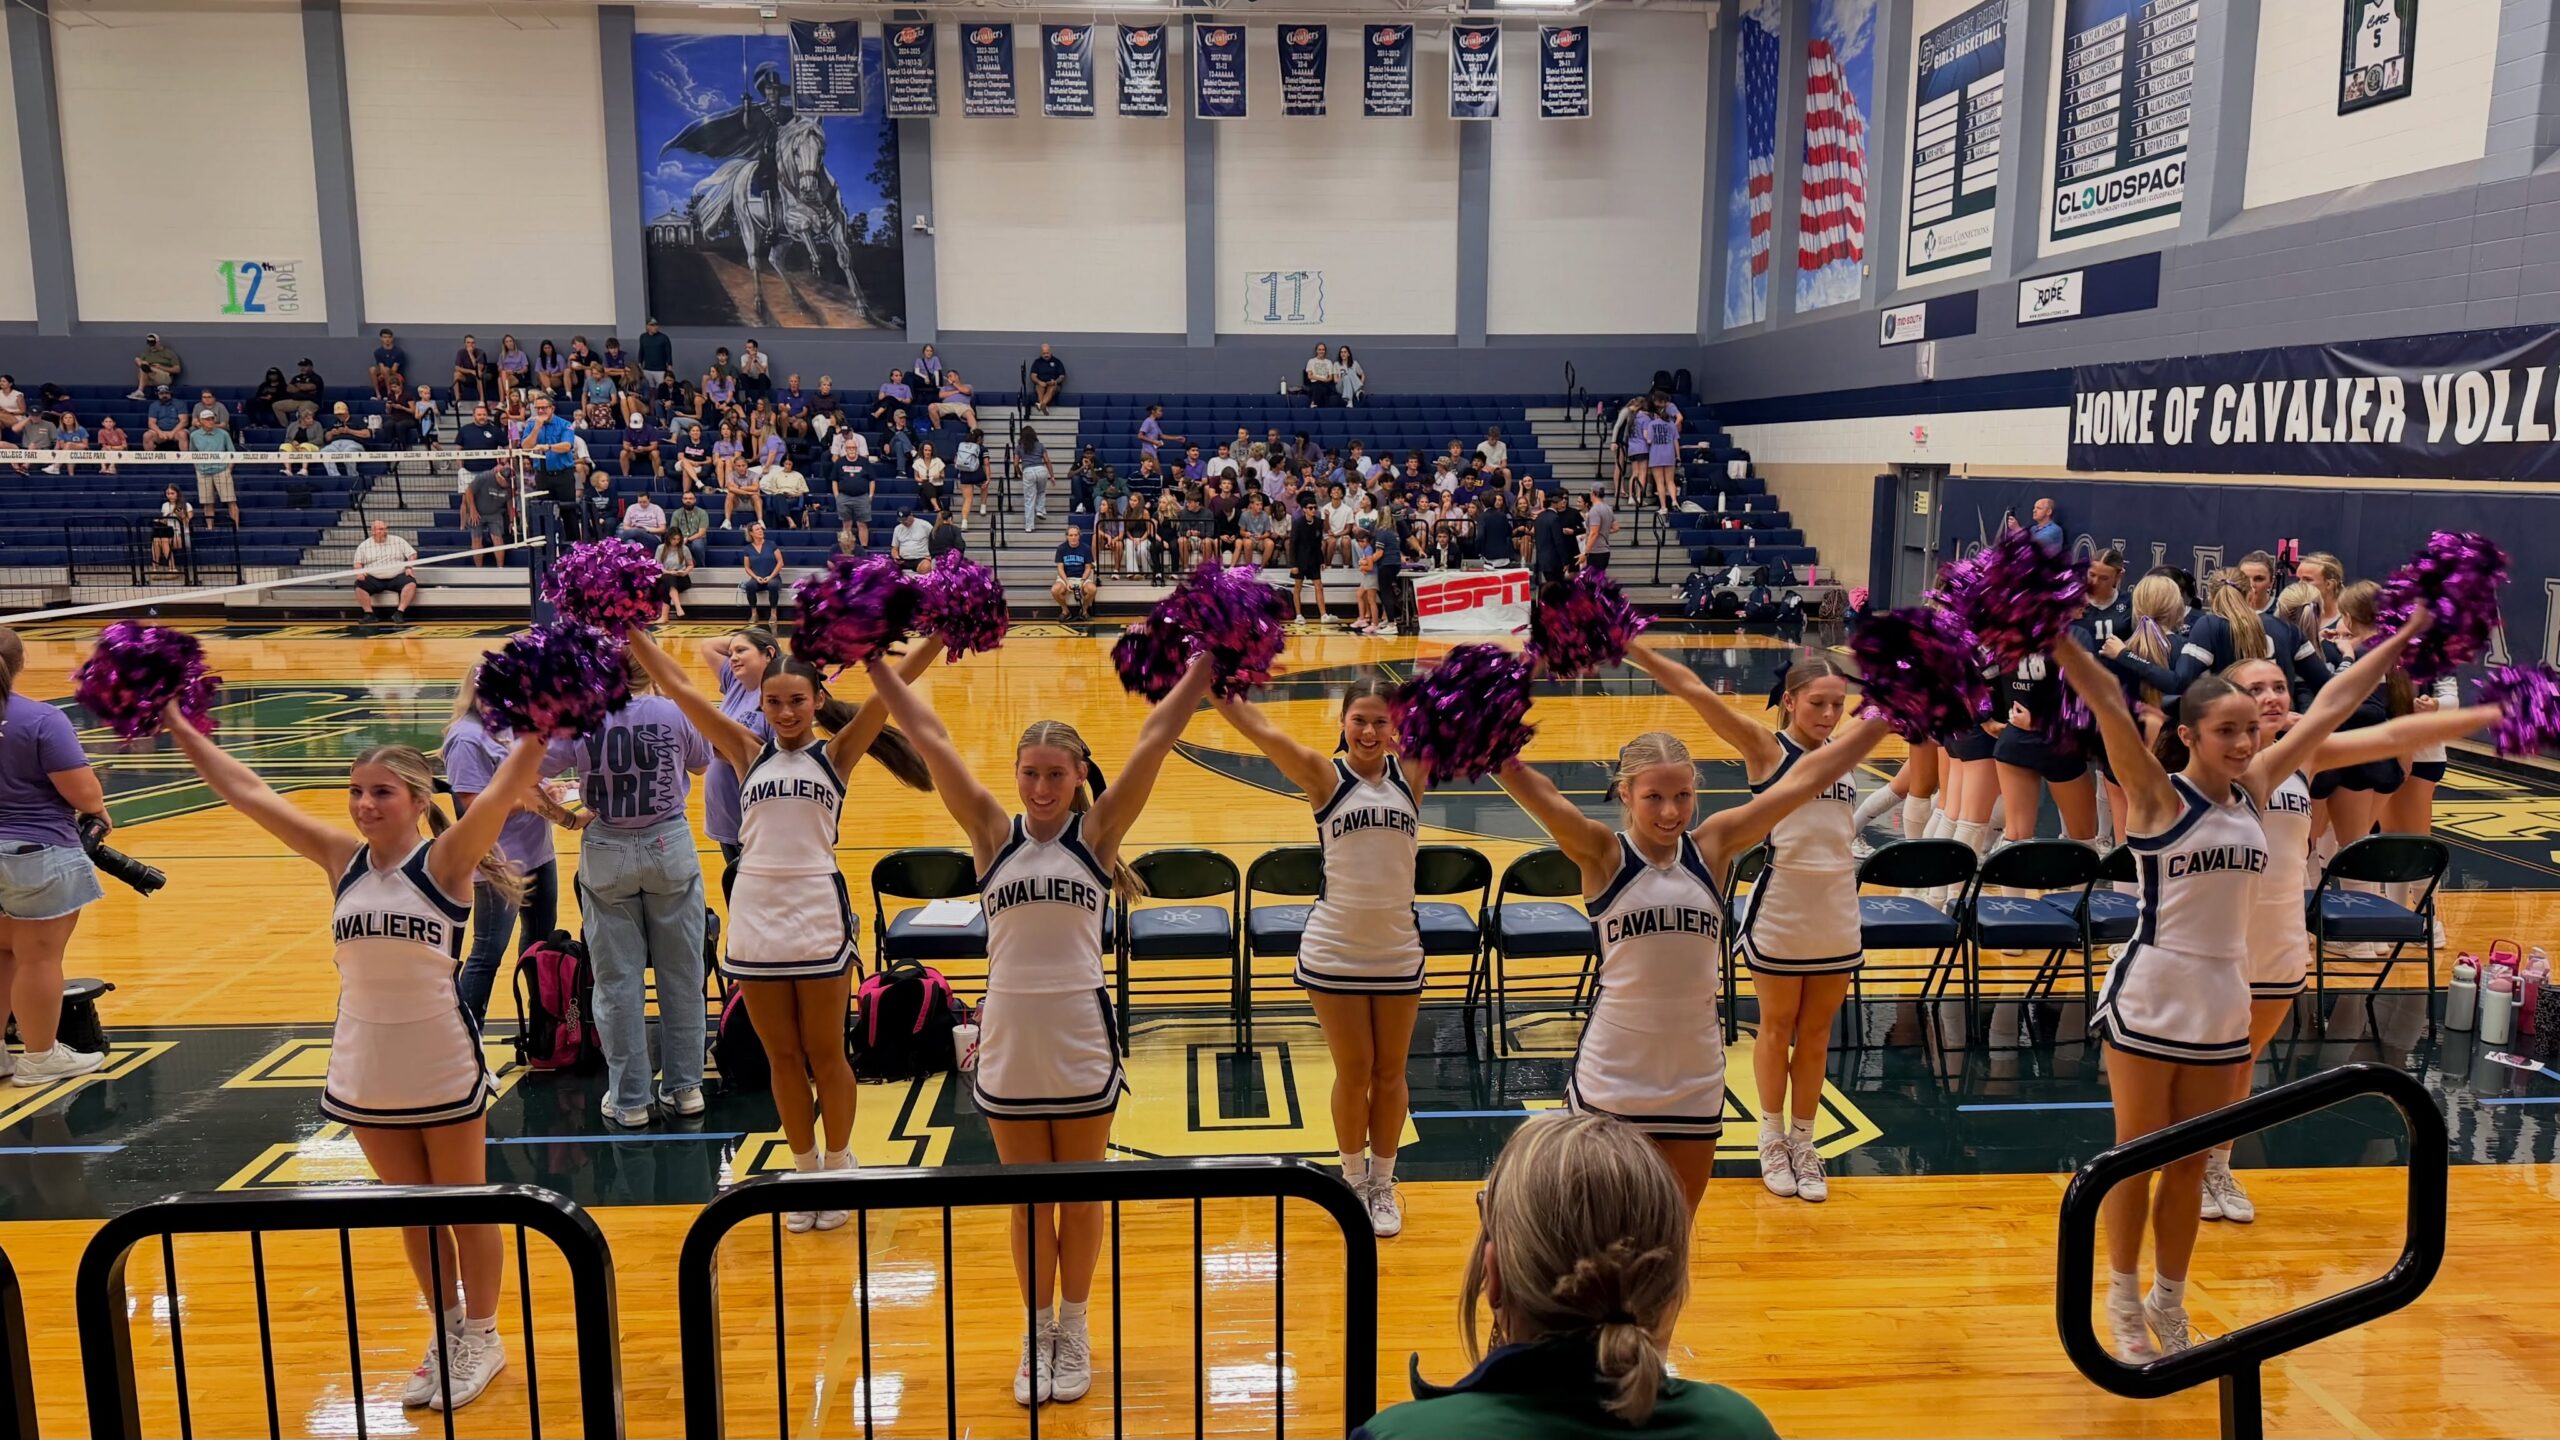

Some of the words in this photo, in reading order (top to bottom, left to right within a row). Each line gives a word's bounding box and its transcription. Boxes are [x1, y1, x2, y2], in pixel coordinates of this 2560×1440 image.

[1936, 16, 1974, 52] COLLEGE
[1976, 1, 2002, 31] PARK
[2154, 38, 2167, 53] DREW
[2169, 27, 2193, 47] CAMERON
[2373, 28, 2381, 48] 5
[1934, 47, 1954, 70] GIRLS
[1956, 23, 2001, 59] BASKETBALL
[2082, 50, 2093, 62] ABBY
[2071, 75, 2075, 87] 3
[2096, 59, 2116, 75] CAMERON
[2139, 84, 2145, 97] 14
[2166, 70, 2190, 87] COLEMAN
[2068, 112, 2072, 123] 5
[2138, 105, 2143, 117] 15
[2136, 124, 2142, 137] 16
[2164, 133, 2179, 148] STEEN
[218, 261, 276, 314] 12th
[274, 263, 299, 311] GRADE
[1260, 271, 1309, 320] 11th
[2039, 287, 2063, 306] ROPE
[2073, 389, 2158, 447] HOME
[2162, 386, 2206, 447] OF
[2210, 376, 2405, 447] CAVALIER
[2419, 366, 2560, 446] VOLL
[1652, 424, 1668, 434] YOU
[1653, 435, 1668, 444] ARE
[1416, 571, 1531, 617] ESPN
[2094, 619, 2114, 640] 11
[585, 723, 658, 774] YOU
[638, 724, 681, 812] enough
[586, 771, 657, 818] ARE
[742, 780, 834, 812] CAVALIERS
[1332, 808, 1416, 838] CAVALIERS
[988, 878, 1096, 917] CAVALIERS
[332, 913, 442, 945] AVALIERS
[1606, 905, 1720, 944] CAVALIERS
